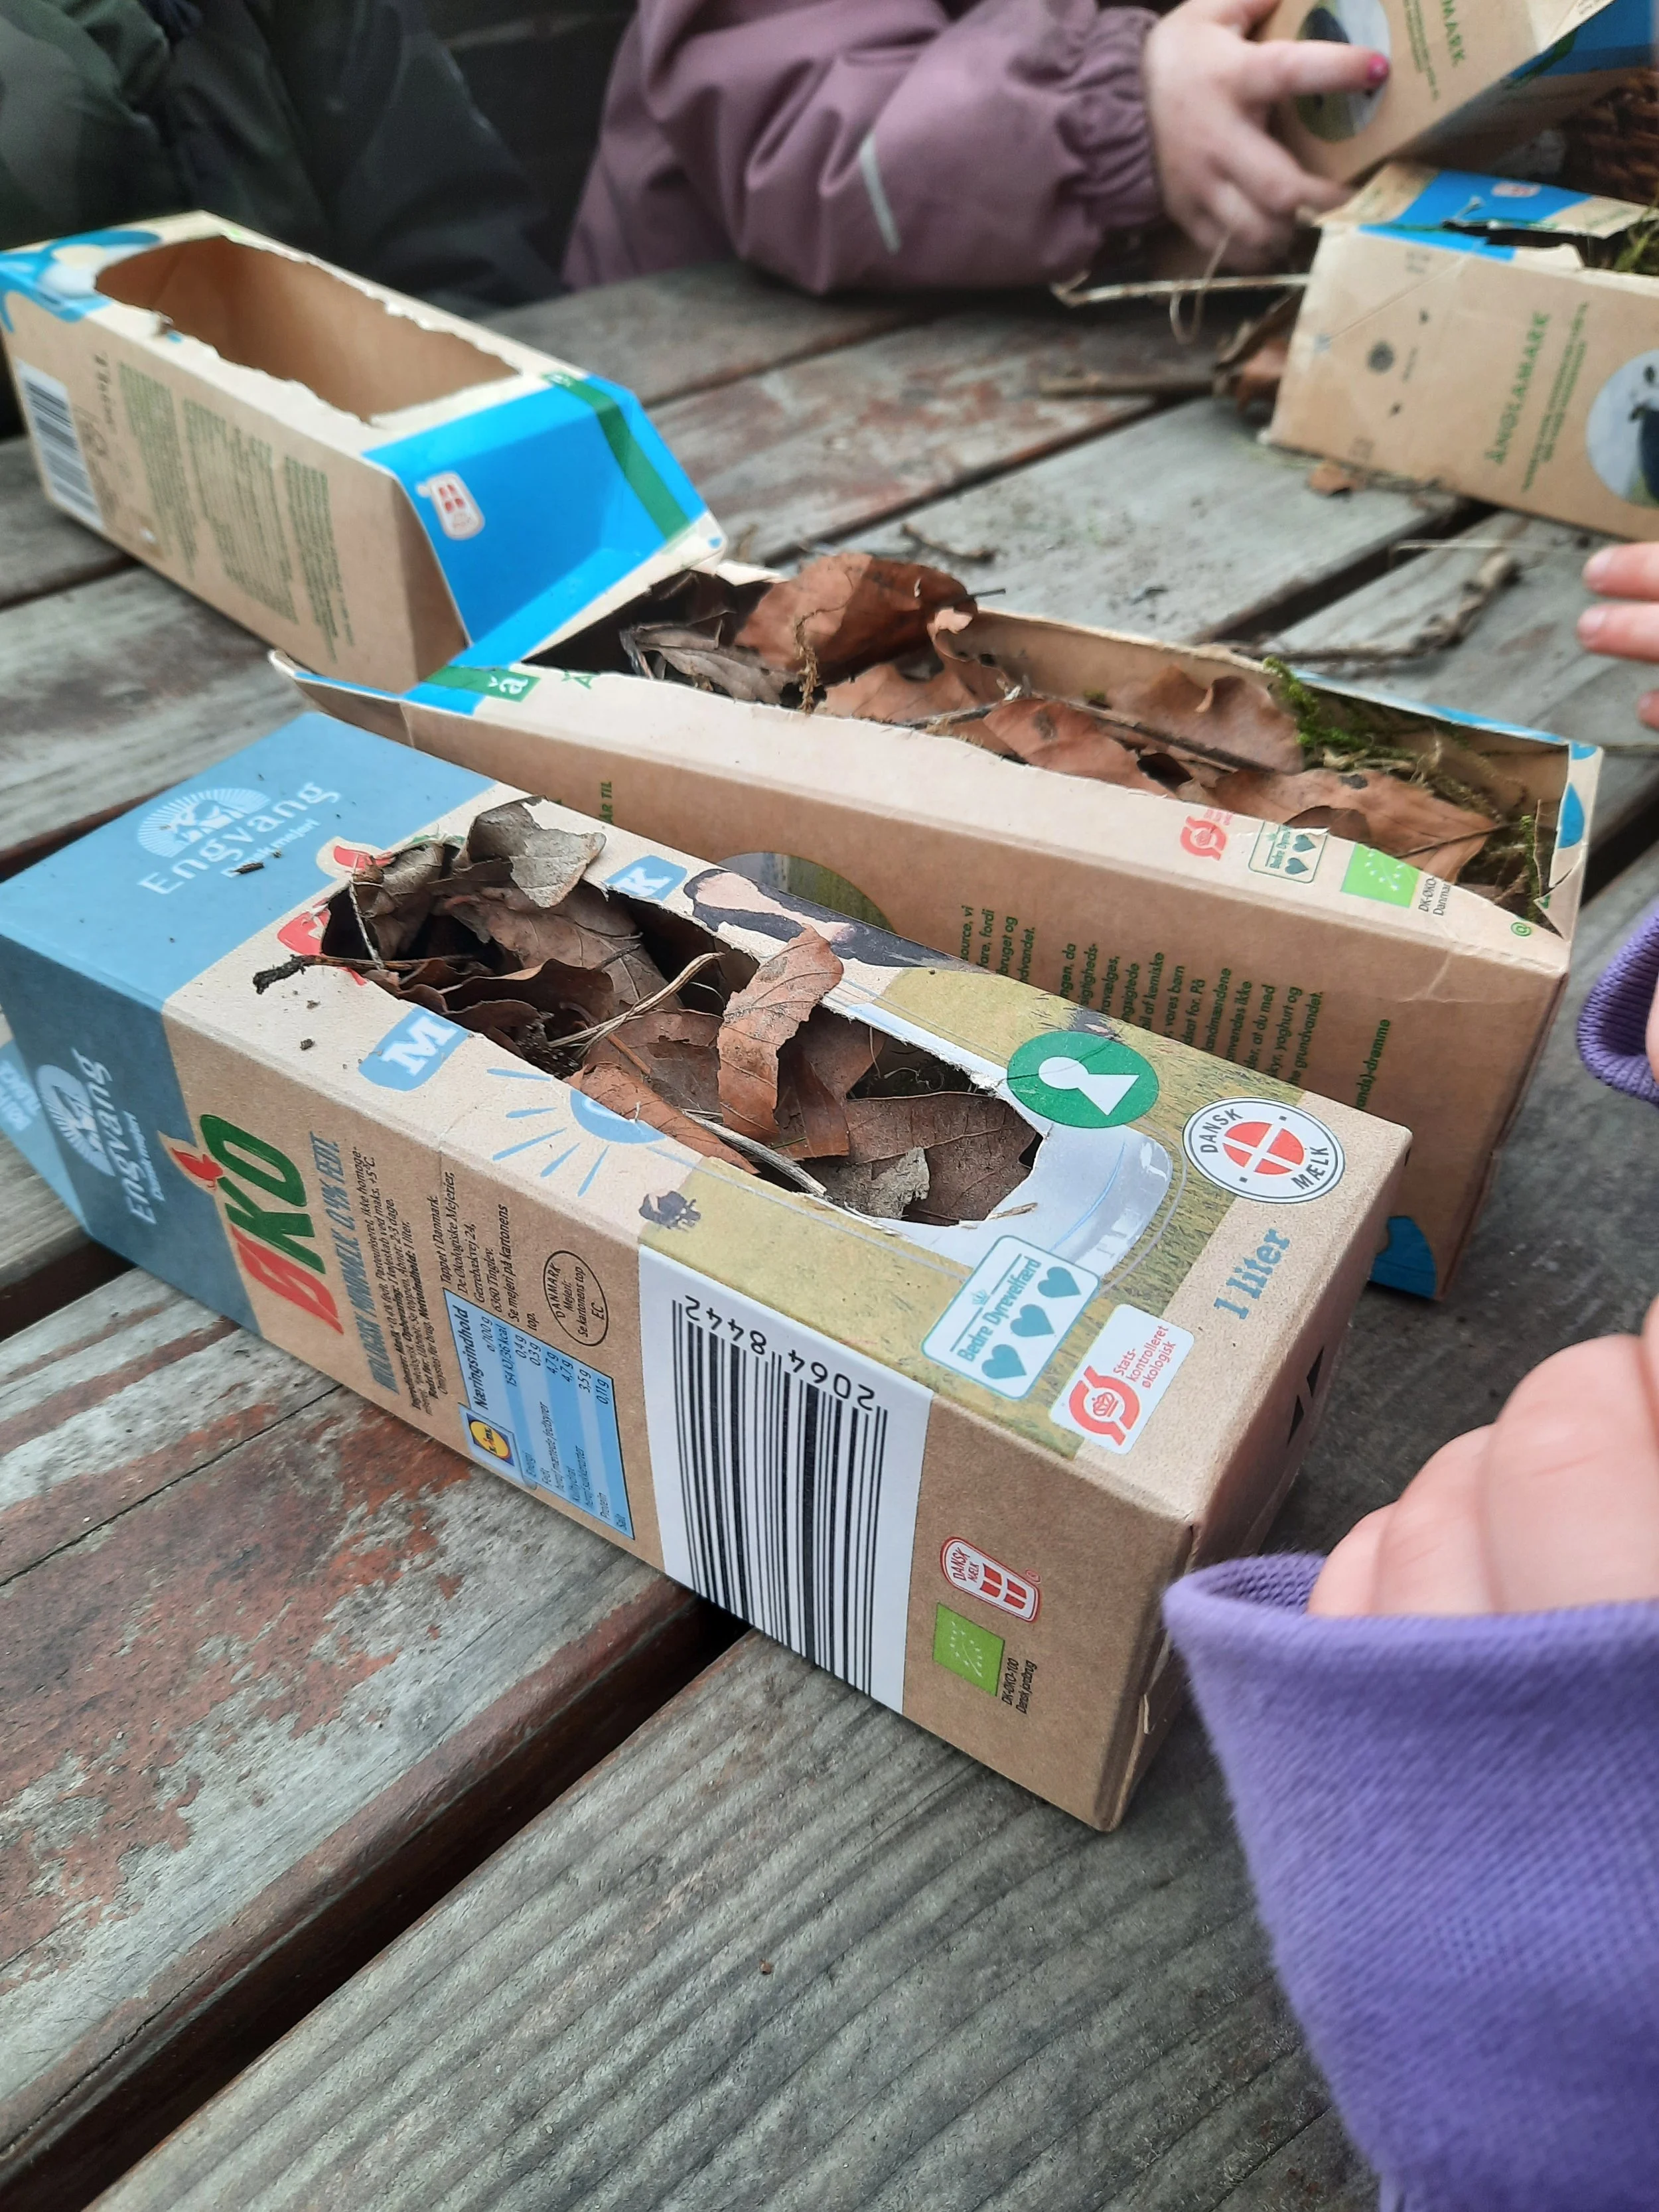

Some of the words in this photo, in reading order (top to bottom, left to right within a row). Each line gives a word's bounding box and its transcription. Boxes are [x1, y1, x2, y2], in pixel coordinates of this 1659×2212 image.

[137, 781, 341, 895] Engvang
[978, 908, 994, 938] fordi
[1005, 916, 1018, 933] og
[1061, 942, 1076, 960] da
[1143, 952, 1164, 999] kemiske
[1167, 965, 1185, 994] børn
[1190, 978, 1205, 994] På
[1141, 999, 1154, 1015] af
[1165, 996, 1179, 1027] vores
[1252, 1014, 1268, 1031] du
[1260, 984, 1275, 1013] med
[1275, 1005, 1293, 1051] yoghurt
[1287, 986, 1303, 1003] og
[70, 1046, 158, 1224] Engvang
[1200, 1108, 1244, 1153] DANSK
[1290, 1146, 1329, 1190] MÆLK
[352, 1146, 367, 1195] homoge-
[371, 1187, 384, 1217] maks.
[385, 1198, 397, 1226] dage.
[445, 1171, 457, 1222] Mejerier,
[199, 1114, 344, 1335] ØKO
[374, 1215, 388, 1236] ved
[387, 1225, 401, 1245] 2-3
[401, 1220, 413, 1244] liter.
[427, 1195, 444, 1245] Danmark.
[463, 1223, 476, 1241] 24,
[498, 1204, 512, 1260] kartonens
[364, 1219, 386, 1282] Pasteuriseret,
[379, 1237, 397, 1279] køleskab
[394, 1244, 407, 1276] Åbnet:
[449, 1221, 466, 1279] Økologiske
[1225, 1228, 1290, 1299] liter
[436, 1250, 453, 1285] Tappet
[465, 1239, 485, 1303] Gerrebækvej
[483, 1248, 499, 1287] Tinglev.
[500, 1259, 516, 1277] på
[574, 1266, 586, 1284] top
[401, 1278, 417, 1312] toppen.
[457, 1278, 469, 1295] De
[488, 1286, 502, 1313] 6360
[502, 1274, 519, 1309] mejeri
[543, 1260, 566, 1318] DANMARK
[561, 1280, 575, 1313] Mejeri:
[392, 1285, 412, 1342] Opbevaring:
[507, 1308, 520, 1323] Se
[575, 1283, 587, 1326] kartonens
[591, 1301, 605, 1321] EC
[957, 1324, 993, 1363] Bedre
[991, 1256, 1042, 1326] Dyrevelfærd
[1213, 1297, 1249, 1319] 1
[495, 1323, 509, 1346] kcal
[526, 1312, 540, 1331] top.
[577, 1325, 589, 1338] Se
[685, 1295, 766, 1355] 8442
[453, 1305, 488, 1410] Næringsindhold
[514, 1341, 527, 1359] 0,4
[528, 1349, 541, 1366] 0,3
[545, 1357, 559, 1374] 4,7
[1112, 1348, 1137, 1376] Stats-
[1128, 1325, 1169, 1383] kontrolleret
[1141, 1342, 1176, 1389] økologisk
[504, 1370, 517, 1387] 154
[559, 1364, 573, 1383] 4,7
[577, 1375, 591, 1394] 3,5
[789, 1350, 874, 1411] 2064
[595, 1384, 609, 1405] 0,11
[950, 1546, 970, 1582] DANSK
[968, 1561, 979, 1584] MÆLK
[1001, 1657, 1019, 1706] DK-ØKO-100
[1015, 1690, 1029, 1715] Dansk
